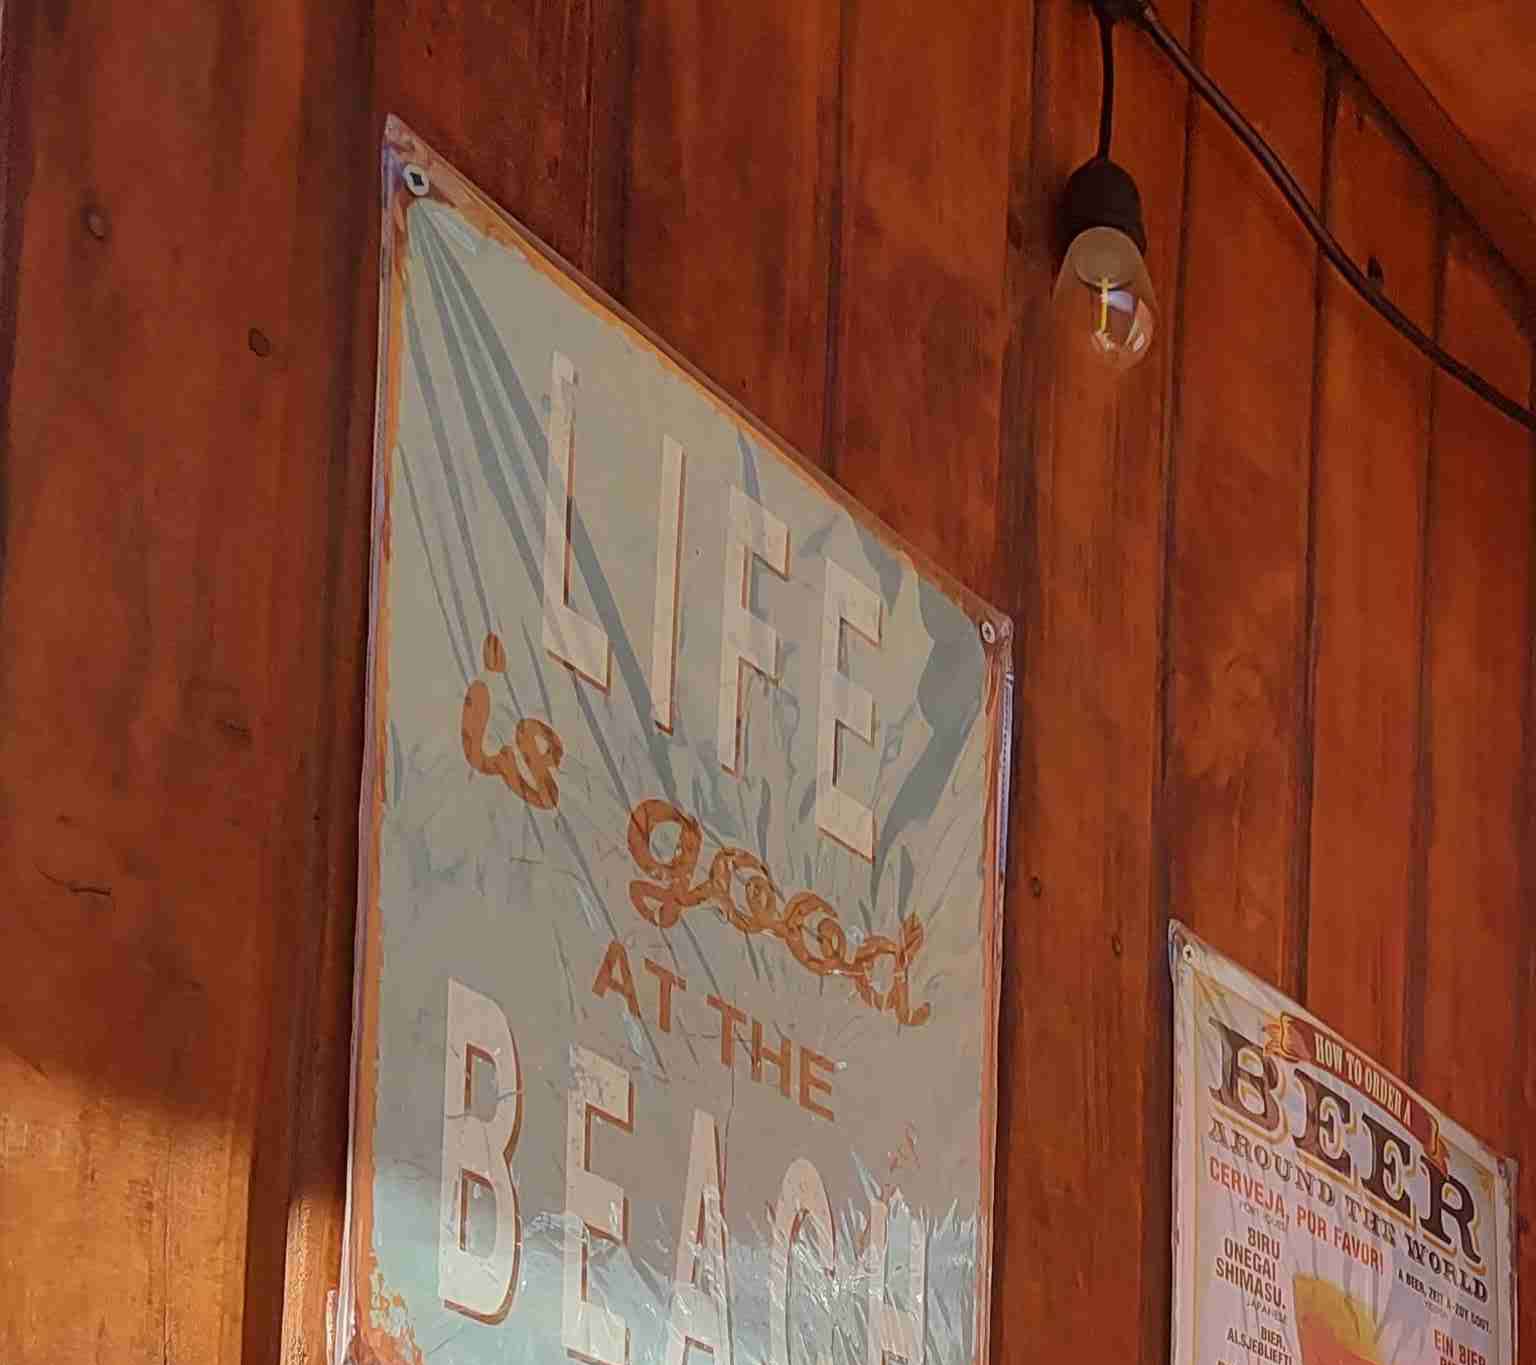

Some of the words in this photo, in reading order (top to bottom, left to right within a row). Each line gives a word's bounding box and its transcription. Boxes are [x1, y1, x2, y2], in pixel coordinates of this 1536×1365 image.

[543, 350, 883, 864] LIFE
[462, 631, 562, 809] is
[628, 799, 930, 1026] good
[593, 940, 688, 1032] AT
[707, 994, 835, 1123] THE
[1313, 1033, 1344, 1073] HOW
[1346, 1050, 1363, 1086] TO
[1364, 1067, 1402, 1116] ORDER
[1402, 1098, 1412, 1128] A
[1208, 1016, 1483, 1265] BEER
[1209, 1156, 1288, 1230] CERVEJA,
[1296, 1205, 1328, 1240] POR
[1208, 1118, 1335, 1206] AROUND
[1345, 1195, 1397, 1248] THE
[1405, 1232, 1488, 1303] WORLD
[1224, 1238, 1277, 1281] ONEGAI
[1248, 1227, 1280, 1260] BIRU
[1216, 1257, 1286, 1309] SHIMASU.
[1434, 1329, 1454, 1358] EIN
